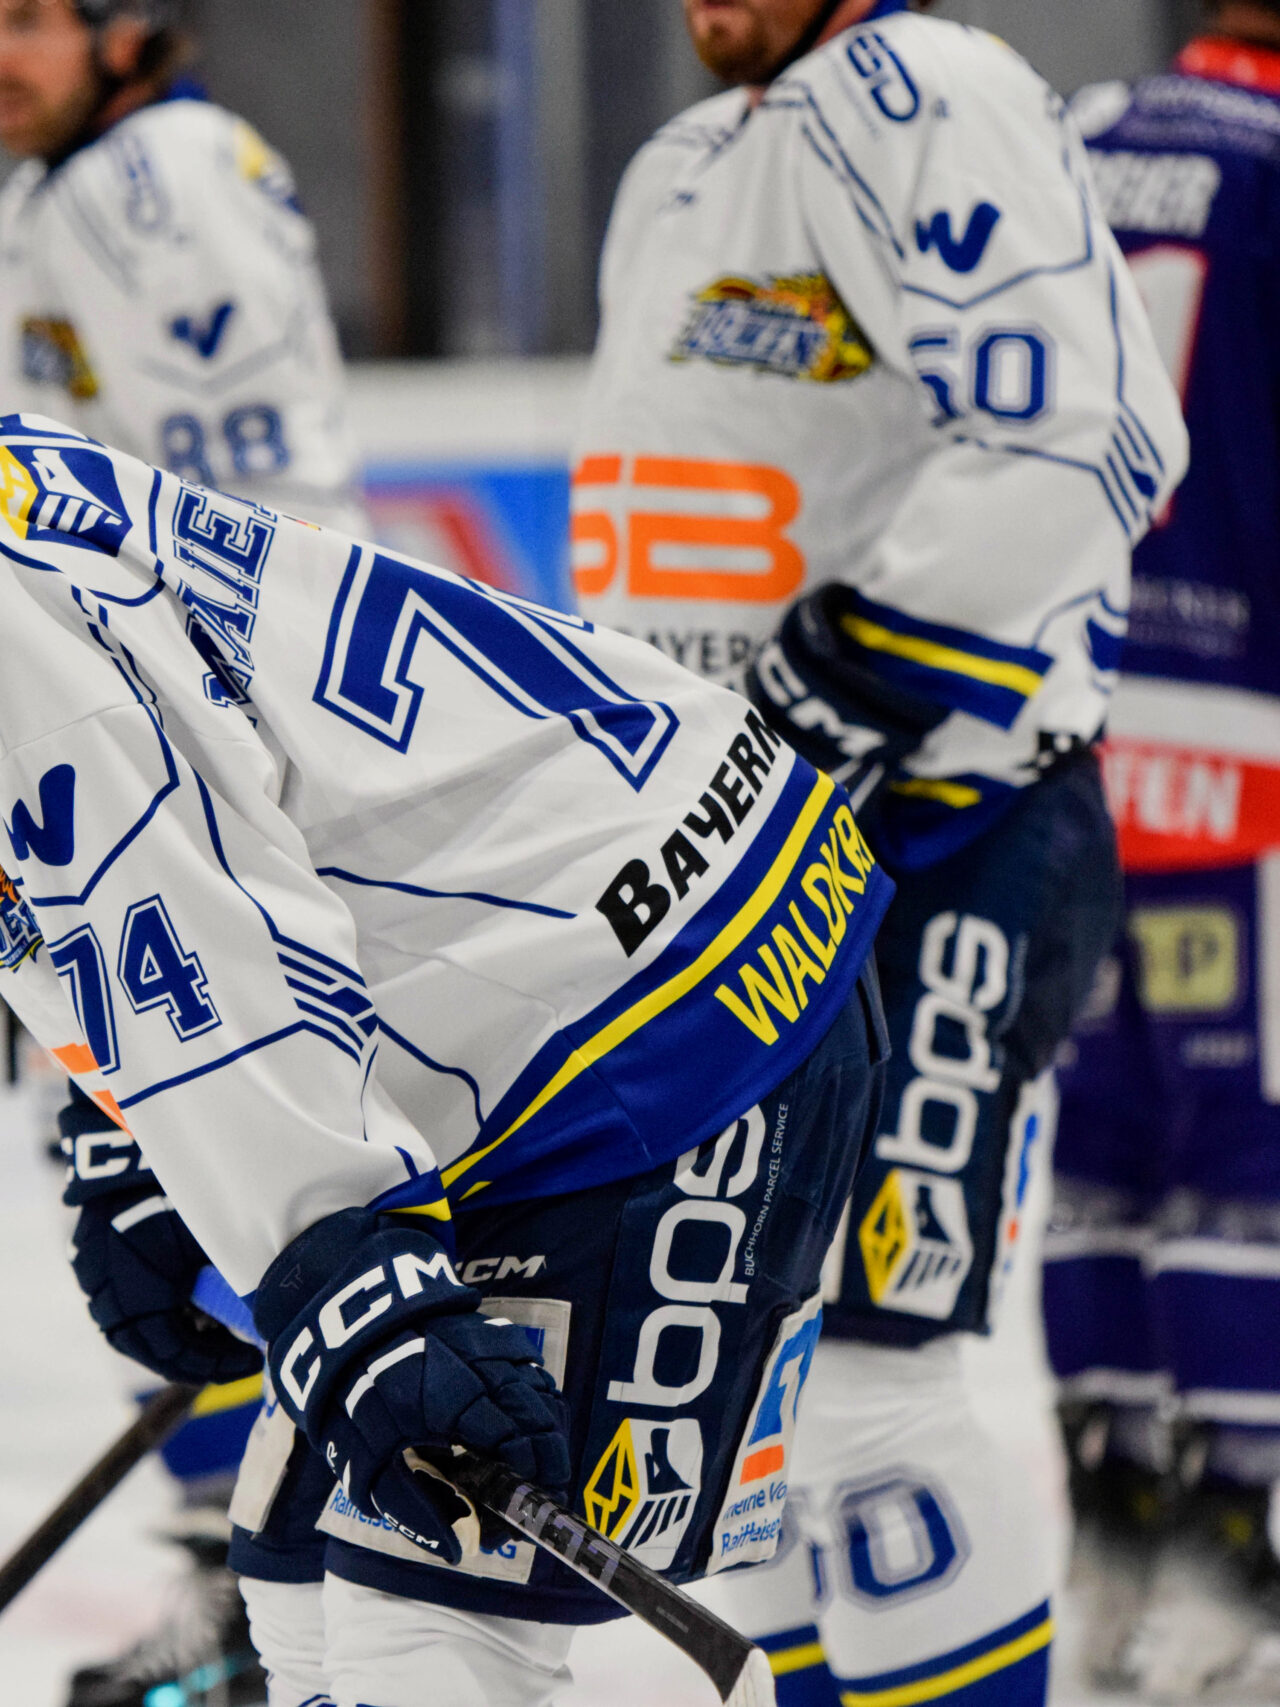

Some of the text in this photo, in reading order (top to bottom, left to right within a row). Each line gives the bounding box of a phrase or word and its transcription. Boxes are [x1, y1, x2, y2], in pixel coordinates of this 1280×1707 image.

[313, 544, 680, 793] 7
[47, 893, 222, 1075] 74
[714, 804, 877, 1047] WALDKR
[455, 1255, 547, 1285] CM
[607, 1103, 766, 1407] bps
[744, 1103, 789, 1277] BUCHHORN PARCEL SERVICE
[280, 1252, 465, 1412] CCM
